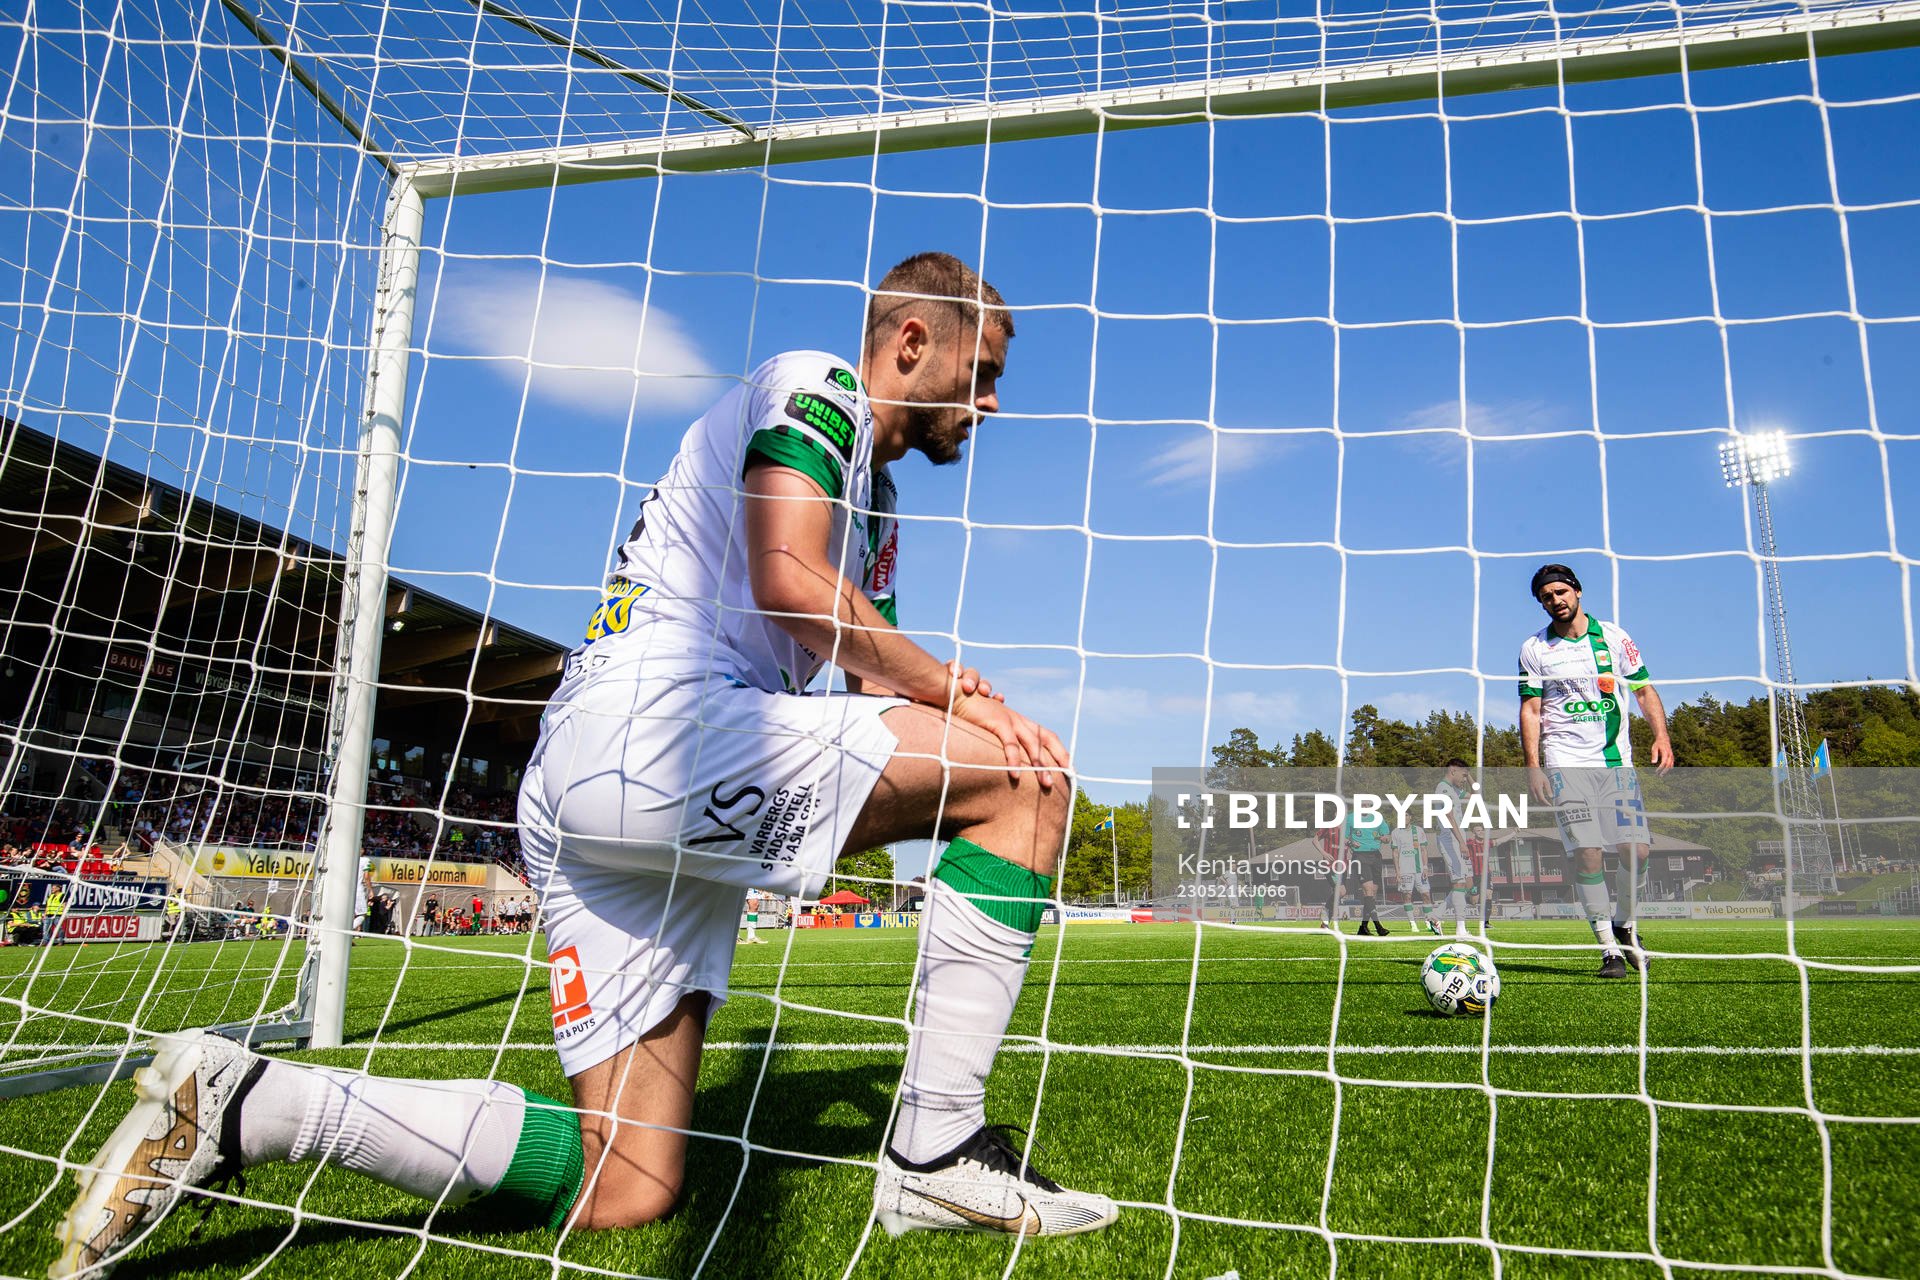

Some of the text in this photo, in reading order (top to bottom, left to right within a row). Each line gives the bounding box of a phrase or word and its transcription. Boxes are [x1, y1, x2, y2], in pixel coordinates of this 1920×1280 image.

[795, 394, 856, 447] UNIBET
[1563, 698, 1615, 715] coop
[750, 787, 790, 855] VARBERGS
[761, 783, 815, 871] STADSHOTELL
[786, 825, 806, 855] ASIA
[248, 855, 280, 874] Yale
[390, 863, 467, 882] Yale Doorman
[1703, 905, 1770, 914] Yale Doorman
[68, 917, 138, 935] UHAUS
[881, 913, 922, 928] MULTIS
[572, 1018, 596, 1035] PUTS
